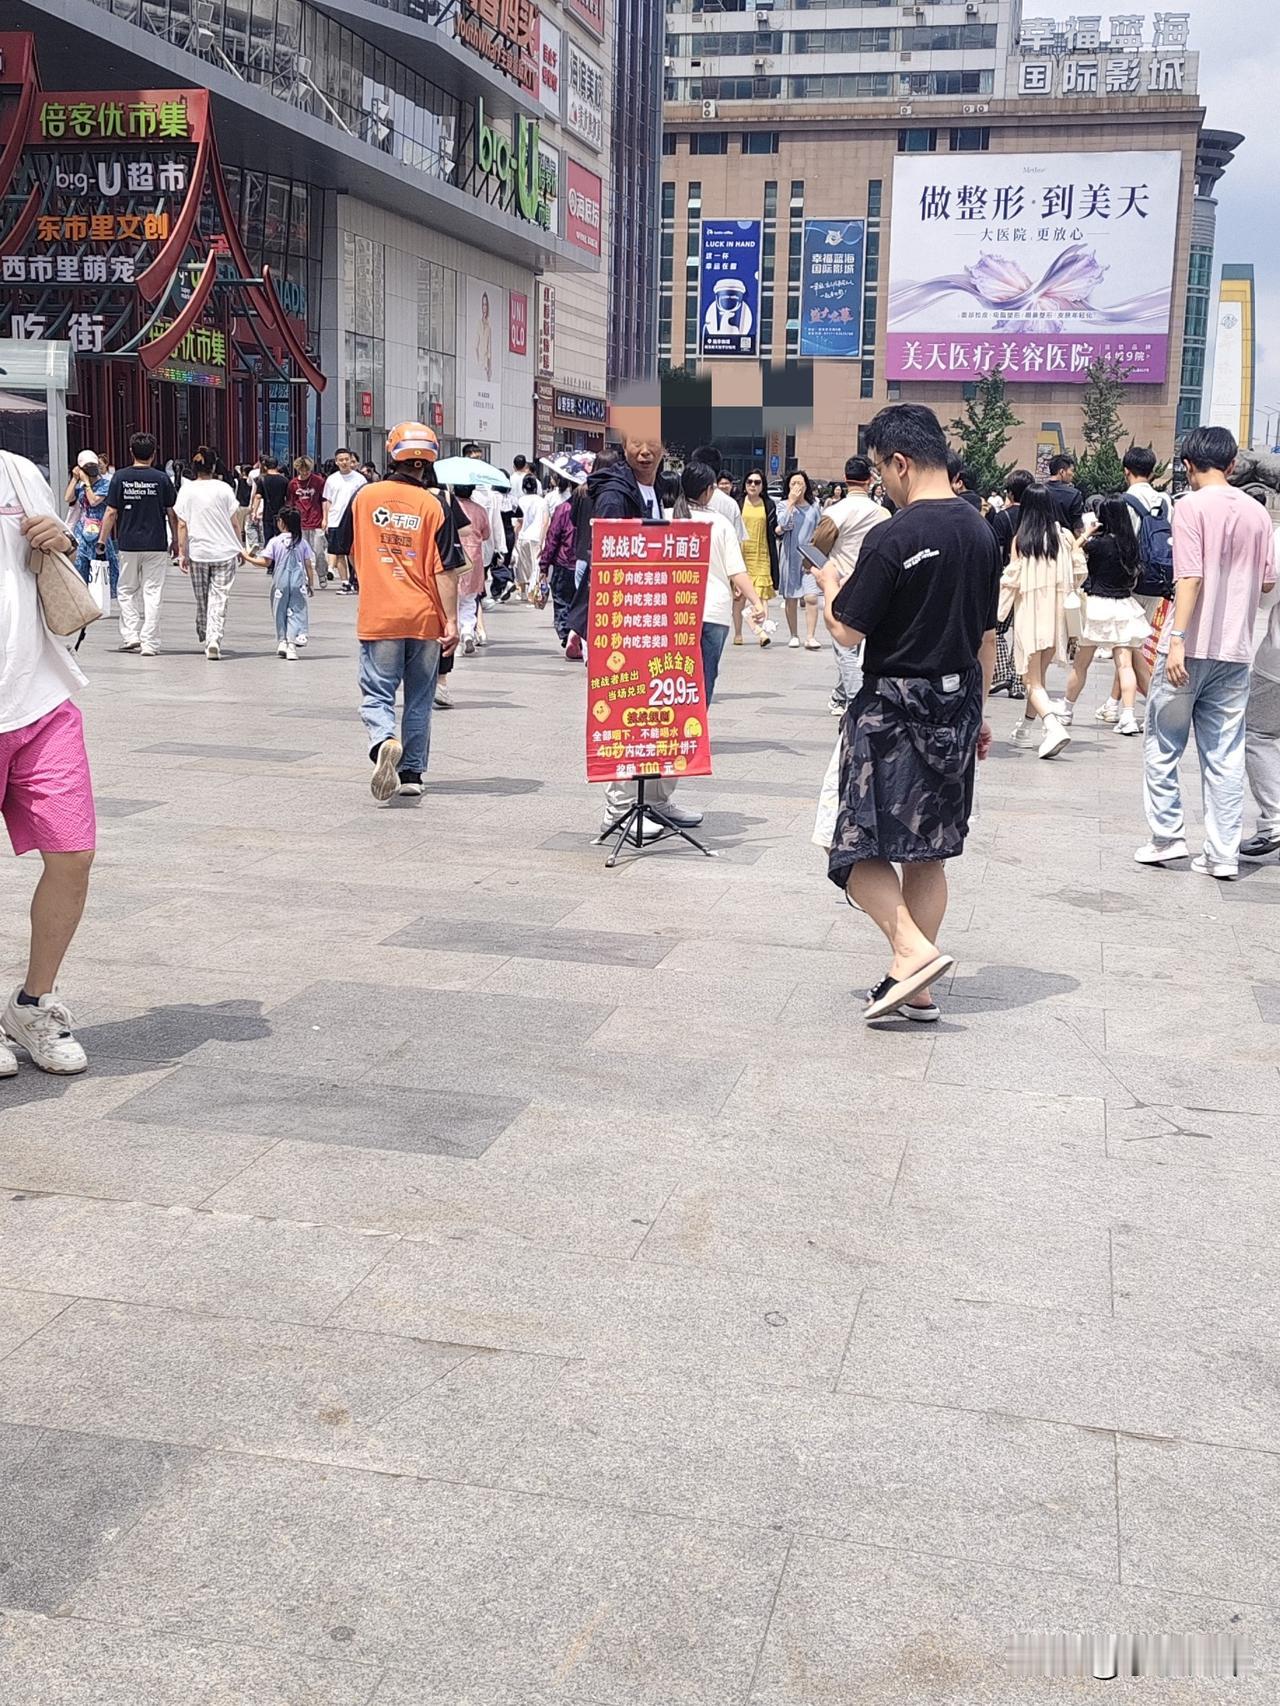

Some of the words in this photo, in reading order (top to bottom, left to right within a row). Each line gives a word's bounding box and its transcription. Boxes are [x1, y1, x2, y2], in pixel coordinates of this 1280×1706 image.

[1018, 12, 1190, 51] 幸福蓝海
[1018, 57, 1185, 95] 国际影城
[40, 103, 188, 137] 倍客优市集
[919, 184, 1149, 221] 做整形·到美天
[37, 213, 169, 241] 东市里文创
[1, 255, 135, 283] 西市里萌宠
[811, 253, 855, 264] 幸福蓝海
[811, 264, 855, 274] 国际影城
[512, 300, 524, 321] UNI
[511, 326, 525, 348] QLO
[901, 341, 1095, 372] 美天医疗美容医院
[391, 513, 420, 529] 千问
[601, 534, 700, 558] 挑战吃一片面包
[672, 570, 700, 584] 1000元
[675, 591, 698, 605] 600元
[673, 612, 696, 626] 300元
[674, 632, 696, 646] 100元
[648, 651, 695, 678] 挑战金额
[591, 670, 639, 689] 挑战者胜出
[608, 684, 646, 701] 当场兑现
[649, 676, 700, 706] 29.9元
[596, 740, 698, 759] 40秒内吃完两片饼干
